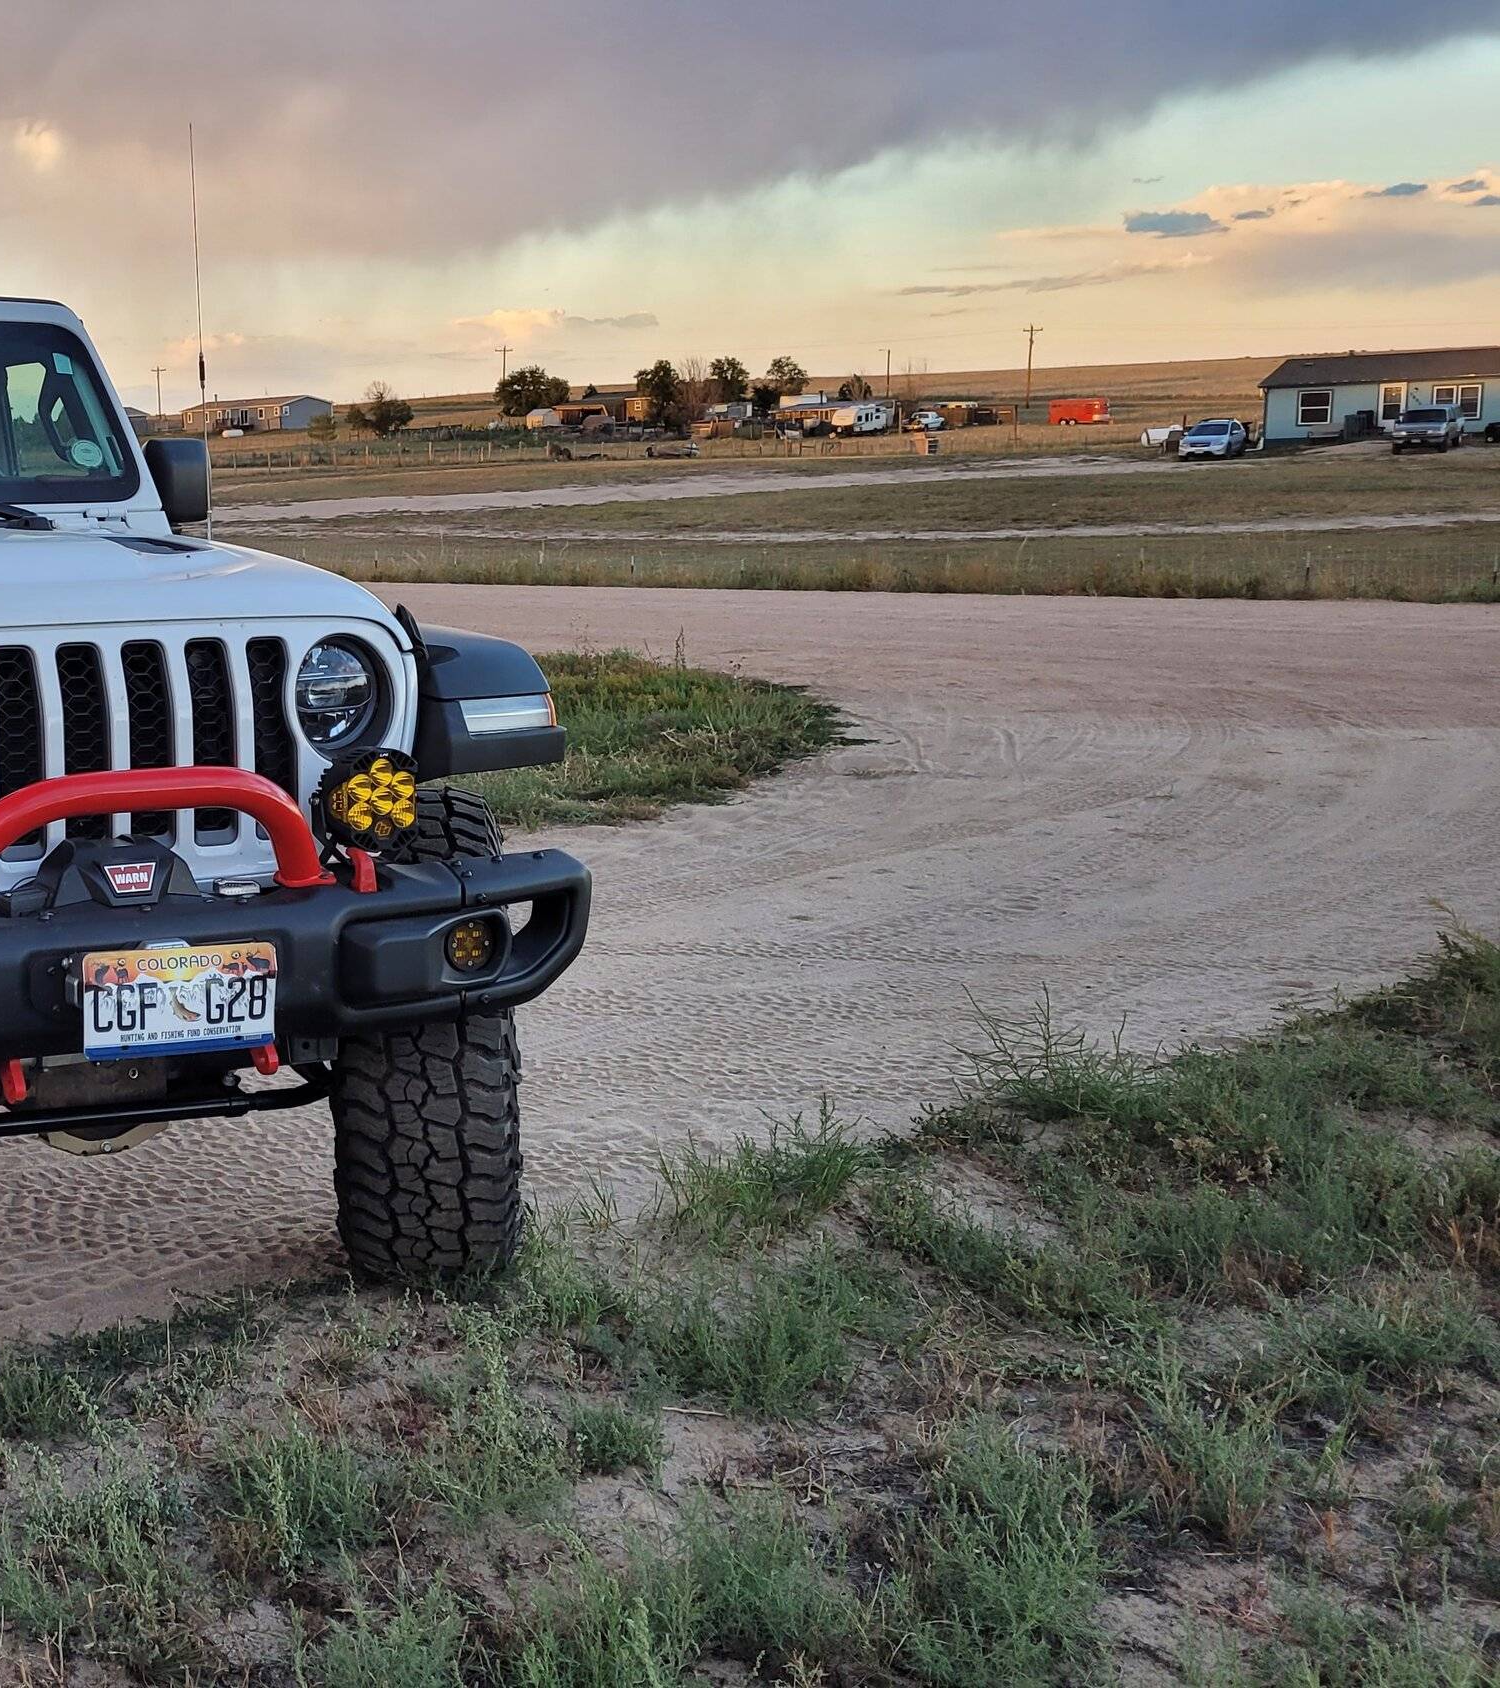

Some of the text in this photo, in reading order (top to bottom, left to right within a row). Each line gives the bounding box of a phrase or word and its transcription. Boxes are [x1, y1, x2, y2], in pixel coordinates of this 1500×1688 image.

[114, 872, 148, 884] WARN
[136, 953, 223, 972] COLORADO
[93, 975, 267, 1032] CGF G28
[119, 1025, 242, 1043] HUNTING AND FISHING FUND CONSERVATION
